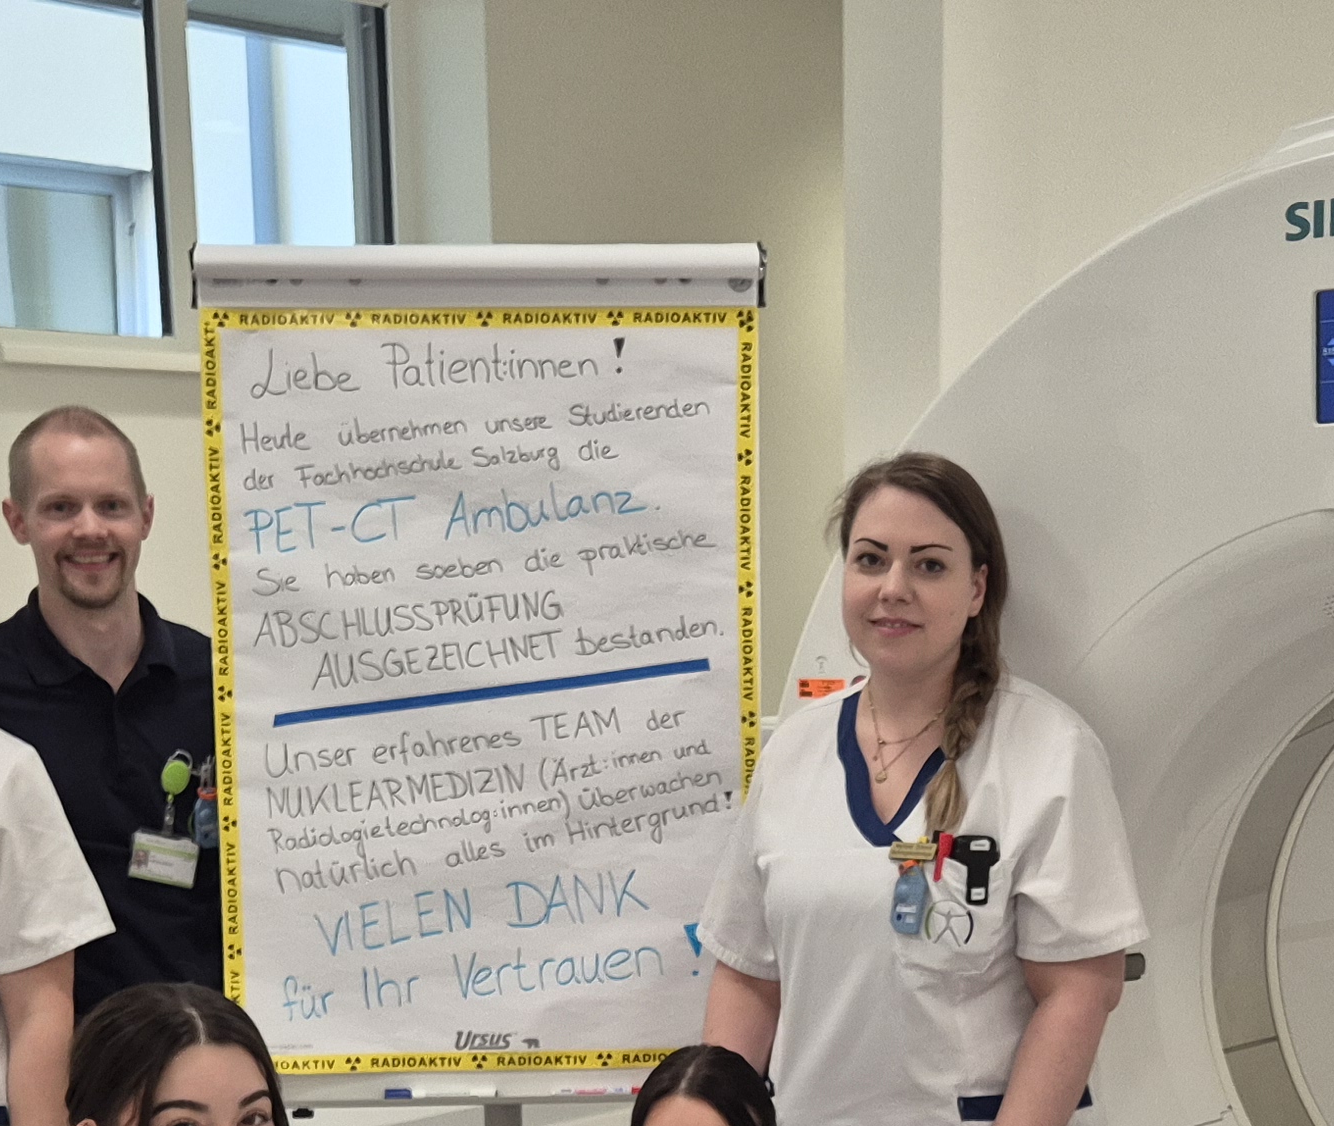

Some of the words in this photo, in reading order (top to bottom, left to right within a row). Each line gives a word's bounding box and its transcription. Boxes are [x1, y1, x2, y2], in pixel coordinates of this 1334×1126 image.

[239, 313, 334, 326] RADIOAKTIV
[371, 313, 466, 325] RADIOAKTIV
[502, 312, 597, 324] RADIOAKTIV
[632, 311, 727, 324] RADIOAKTIV
[204, 322, 217, 409] RADIOAKT
[250, 348, 361, 399] Liebe
[739, 342, 752, 438] RADIOAKTIV
[240, 421, 312, 454] Heute
[337, 417, 467, 446] übernehmen
[485, 415, 553, 434] unsere
[568, 399, 710, 427] Studierenden
[243, 468, 274, 491] der
[294, 449, 463, 489] Fachhochschule
[471, 445, 561, 471] Salzburg
[577, 439, 620, 461] die
[208, 446, 223, 544] RADIOAKTIV
[244, 495, 416, 554] PET-CT
[739, 475, 751, 571] RADIOAKTIV
[252, 567, 300, 596] Sie
[325, 563, 396, 589] haben
[415, 557, 503, 580] soeben
[524, 548, 565, 573] die
[577, 529, 717, 576] praktische
[216, 582, 229, 676] RADIOAKTIV
[253, 589, 565, 648] ABSCHLUSSPRÜFUNG
[311, 629, 563, 691] AUSGEZEICHNET
[574, 615, 724, 656] bestanden.
[741, 607, 753, 701] RADIOAKTIV
[221, 713, 233, 806] RADIOAKTIV
[265, 743, 356, 778] Unser
[372, 730, 522, 766] erfahrenes
[530, 707, 621, 741] TEAM
[646, 709, 686, 731] der
[265, 763, 525, 819] NUKLEARMEDIZIN
[673, 739, 711, 760] und
[275, 849, 417, 894] natürlich
[445, 839, 506, 868] alles
[522, 832, 555, 853] im
[564, 790, 733, 844] Hintergrund!
[226, 842, 238, 935] RADIOAKTIV
[314, 888, 473, 957] VIELEN
[505, 869, 650, 928] DANK
[282, 975, 335, 1022] für
[363, 965, 420, 1009] Ihr
[452, 945, 664, 1000] Vertrauen
[274, 1060, 335, 1070] IOAKTIV
[370, 1057, 462, 1068] RADIOAKTIV
[496, 1055, 587, 1066] RADIOAKTIV
[622, 1053, 668, 1063] RADIO
[455, 1030, 513, 1050] Ursus
